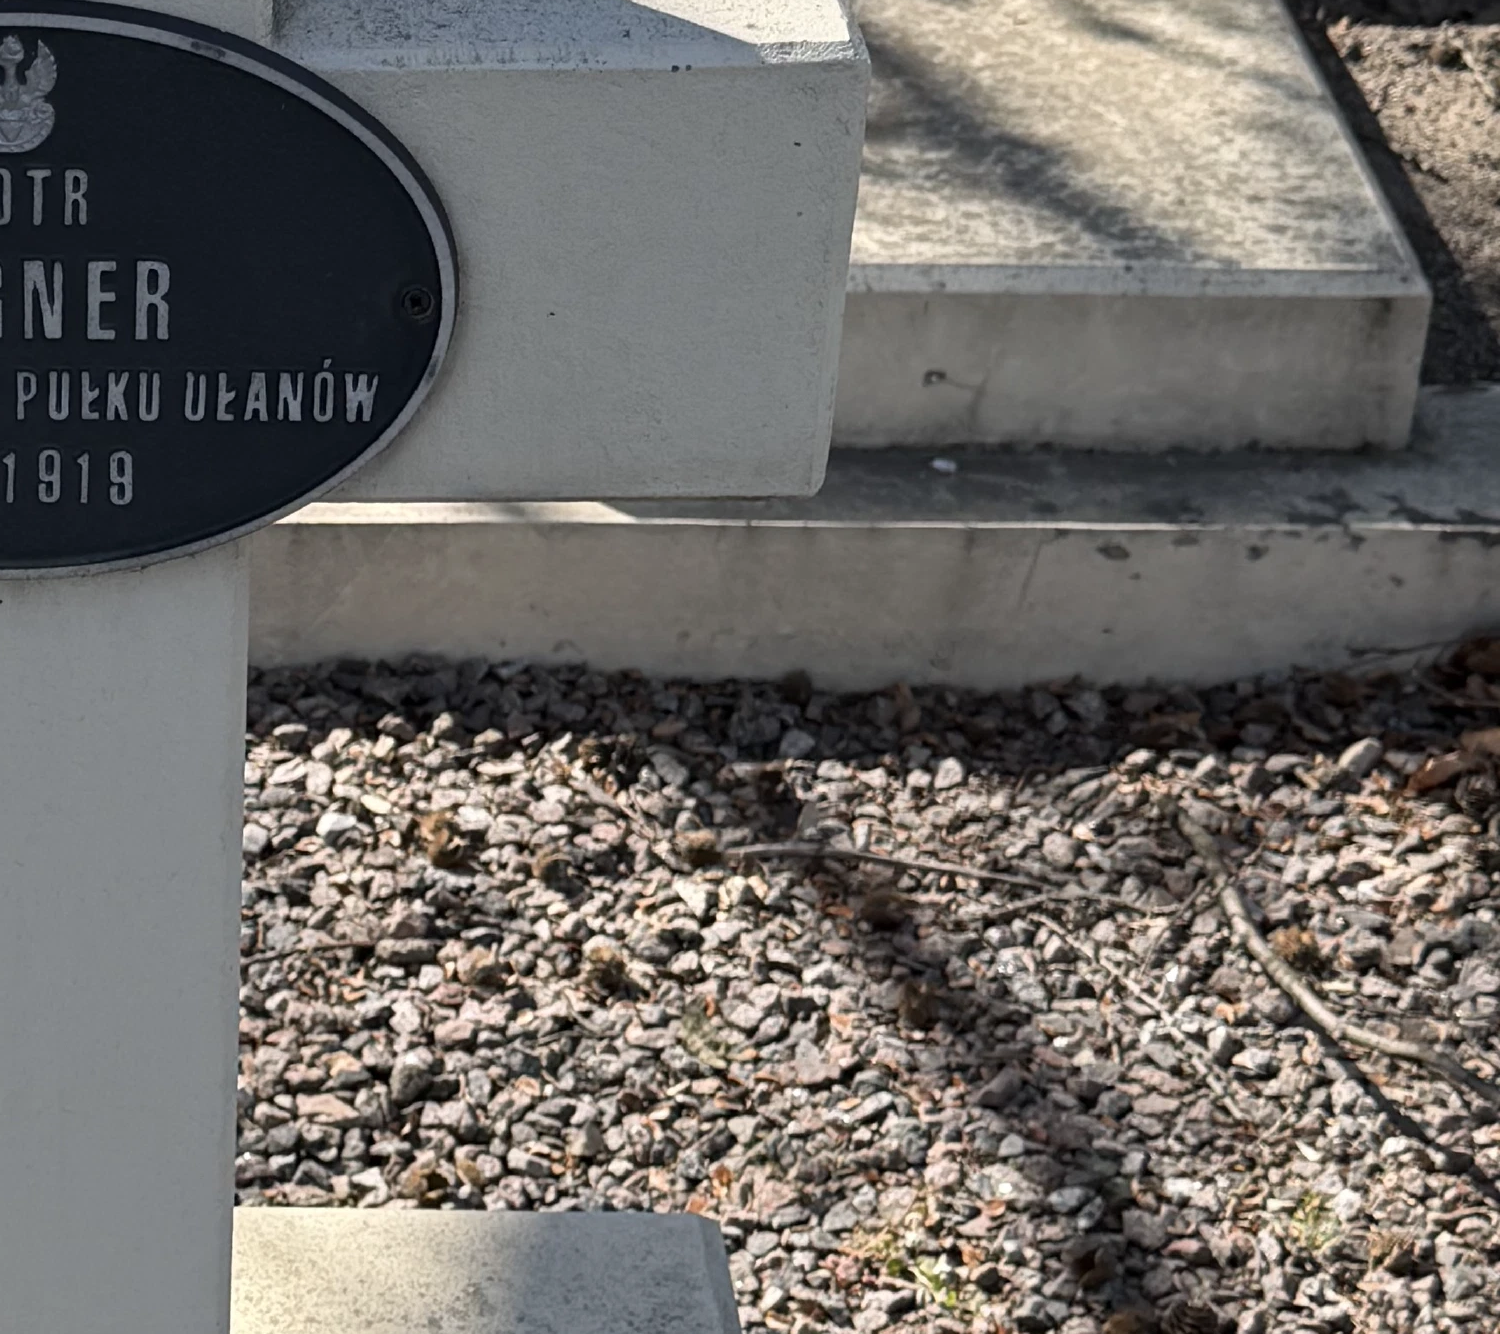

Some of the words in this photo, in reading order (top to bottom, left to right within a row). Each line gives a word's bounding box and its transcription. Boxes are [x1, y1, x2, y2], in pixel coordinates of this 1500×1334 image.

[16, 370, 161, 421] PUŁKU
[184, 358, 380, 423] UŁANÓW
[2, 448, 134, 506] 1919
